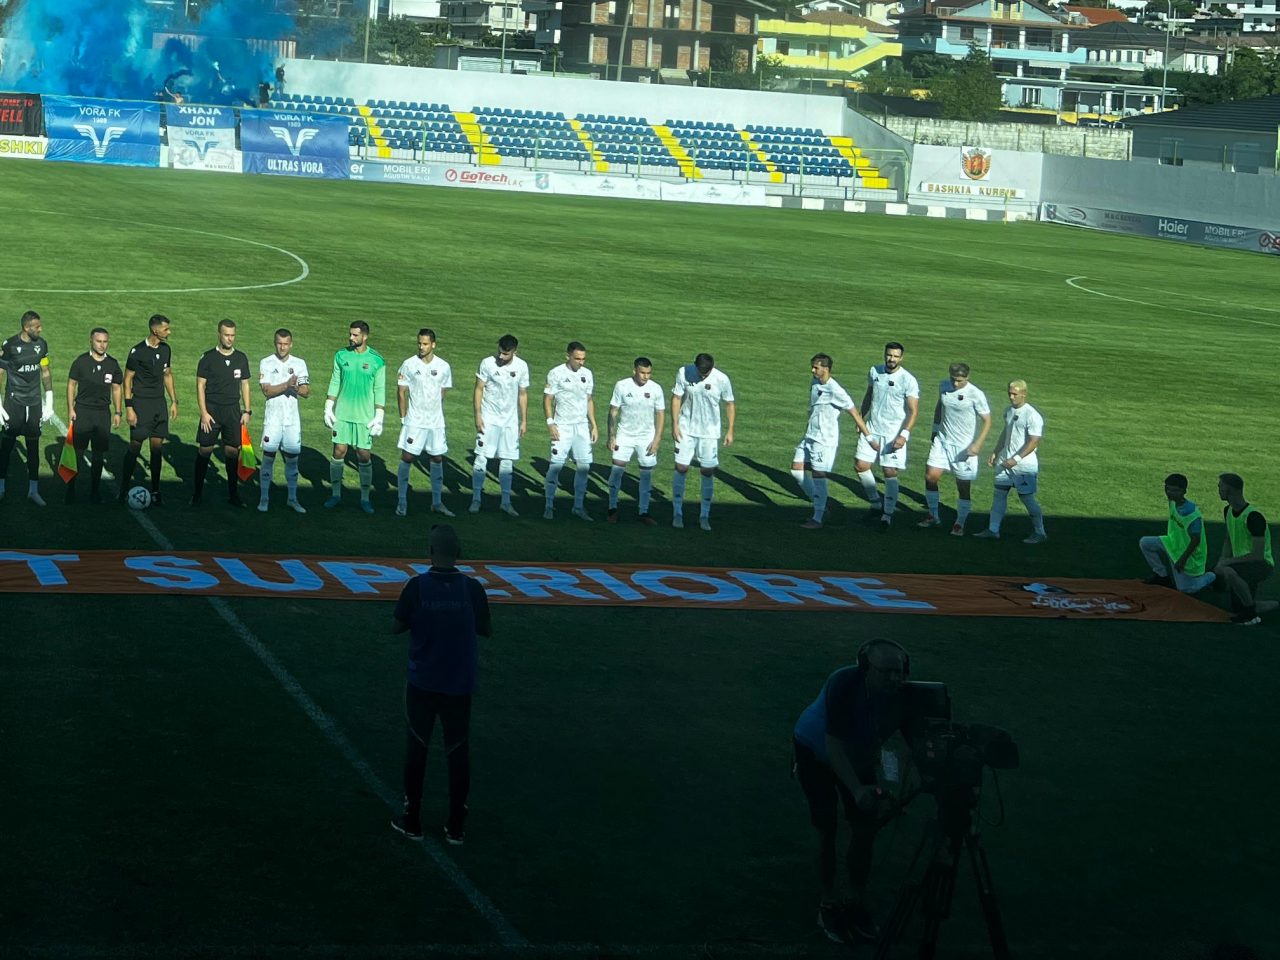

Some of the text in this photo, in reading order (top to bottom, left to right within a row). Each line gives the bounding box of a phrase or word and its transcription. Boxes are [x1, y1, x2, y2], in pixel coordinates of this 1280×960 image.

[24, 98, 35, 107] TO
[79, 107, 120, 118] VORA FK
[178, 105, 222, 116] XHAJA
[188, 116, 215, 126] JON
[273, 113, 300, 121] VORA
[267, 159, 324, 174] ULTRAS VORA
[350, 164, 365, 174] er
[383, 164, 431, 175] MOBILERI
[460, 171, 508, 182] GoTech
[927, 183, 1017, 198] BASHKIA KURBIN
[1158, 219, 1189, 234] Haier
